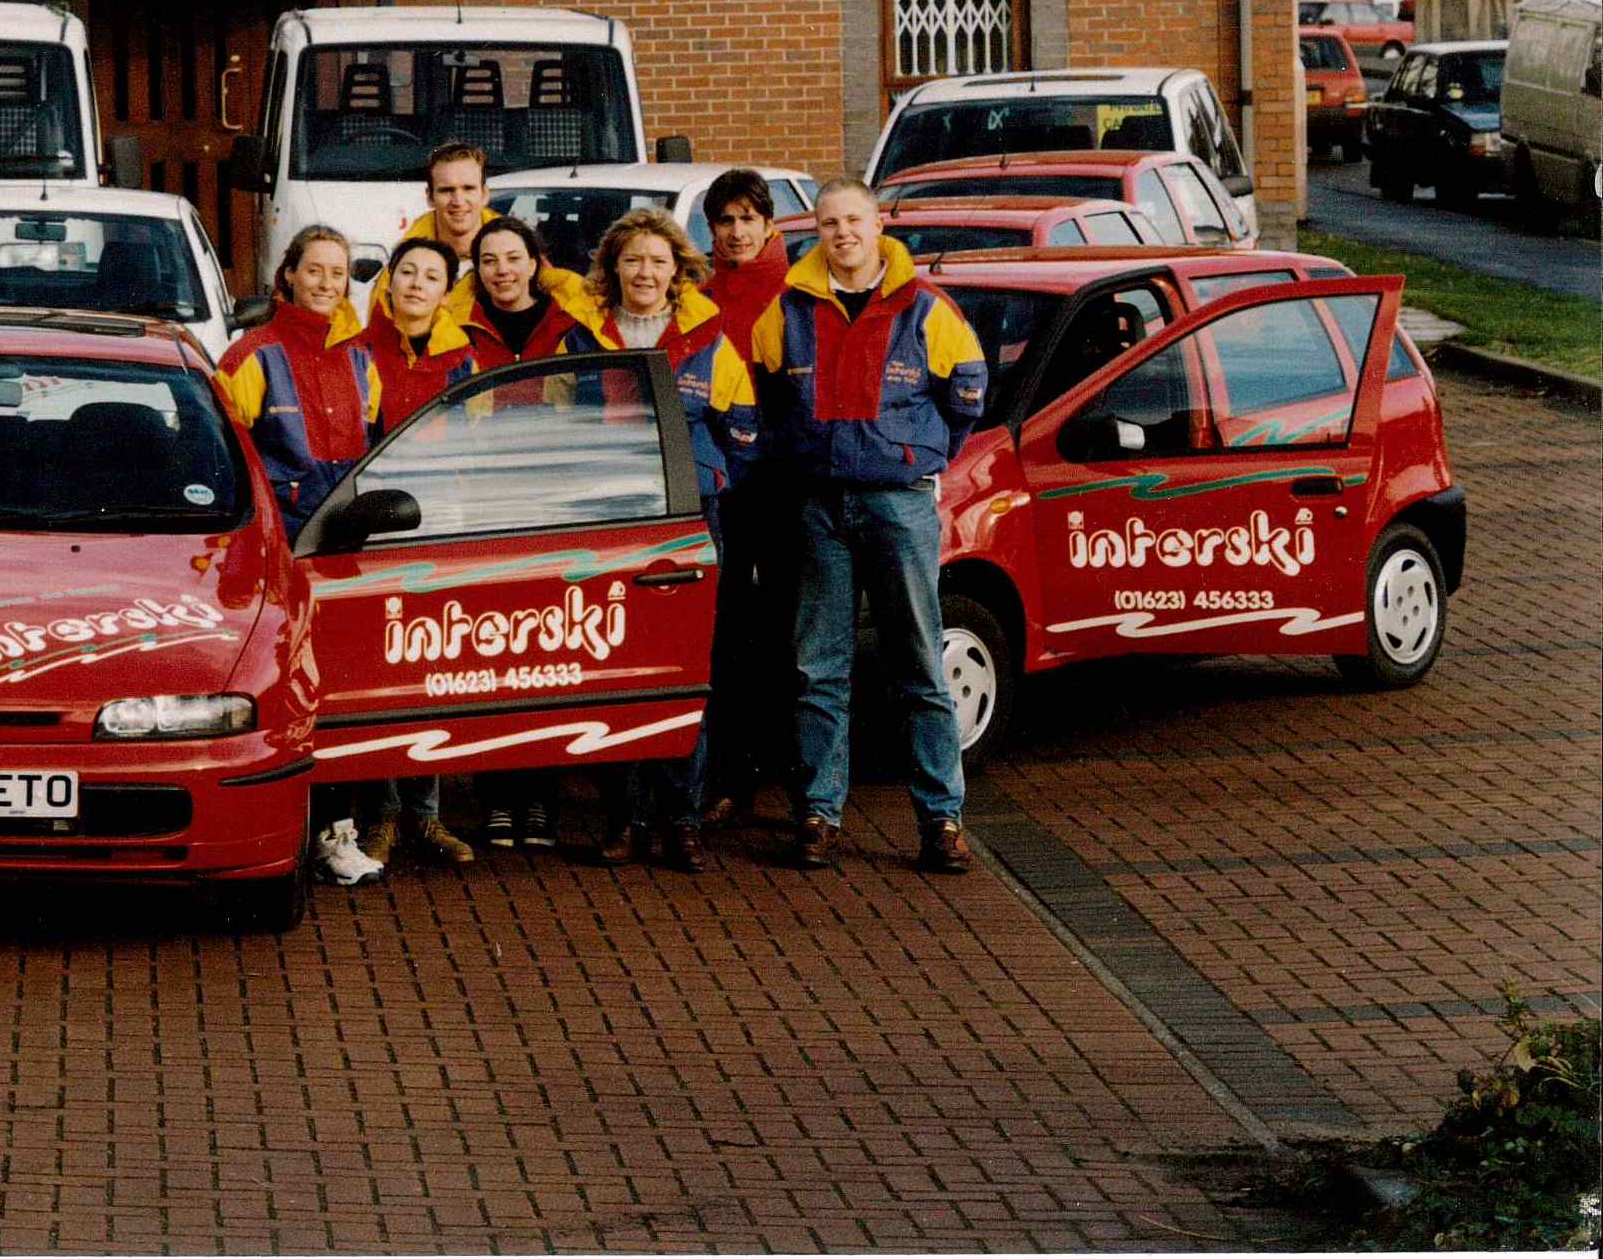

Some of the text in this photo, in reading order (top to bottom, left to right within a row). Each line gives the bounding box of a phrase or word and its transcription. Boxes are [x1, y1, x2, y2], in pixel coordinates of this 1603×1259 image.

[1067, 510, 1315, 576] interski
[384, 580, 627, 665] interski
[1114, 589, 1275, 611] (01623) 456333
[424, 662, 584, 697] (01623) 456333
